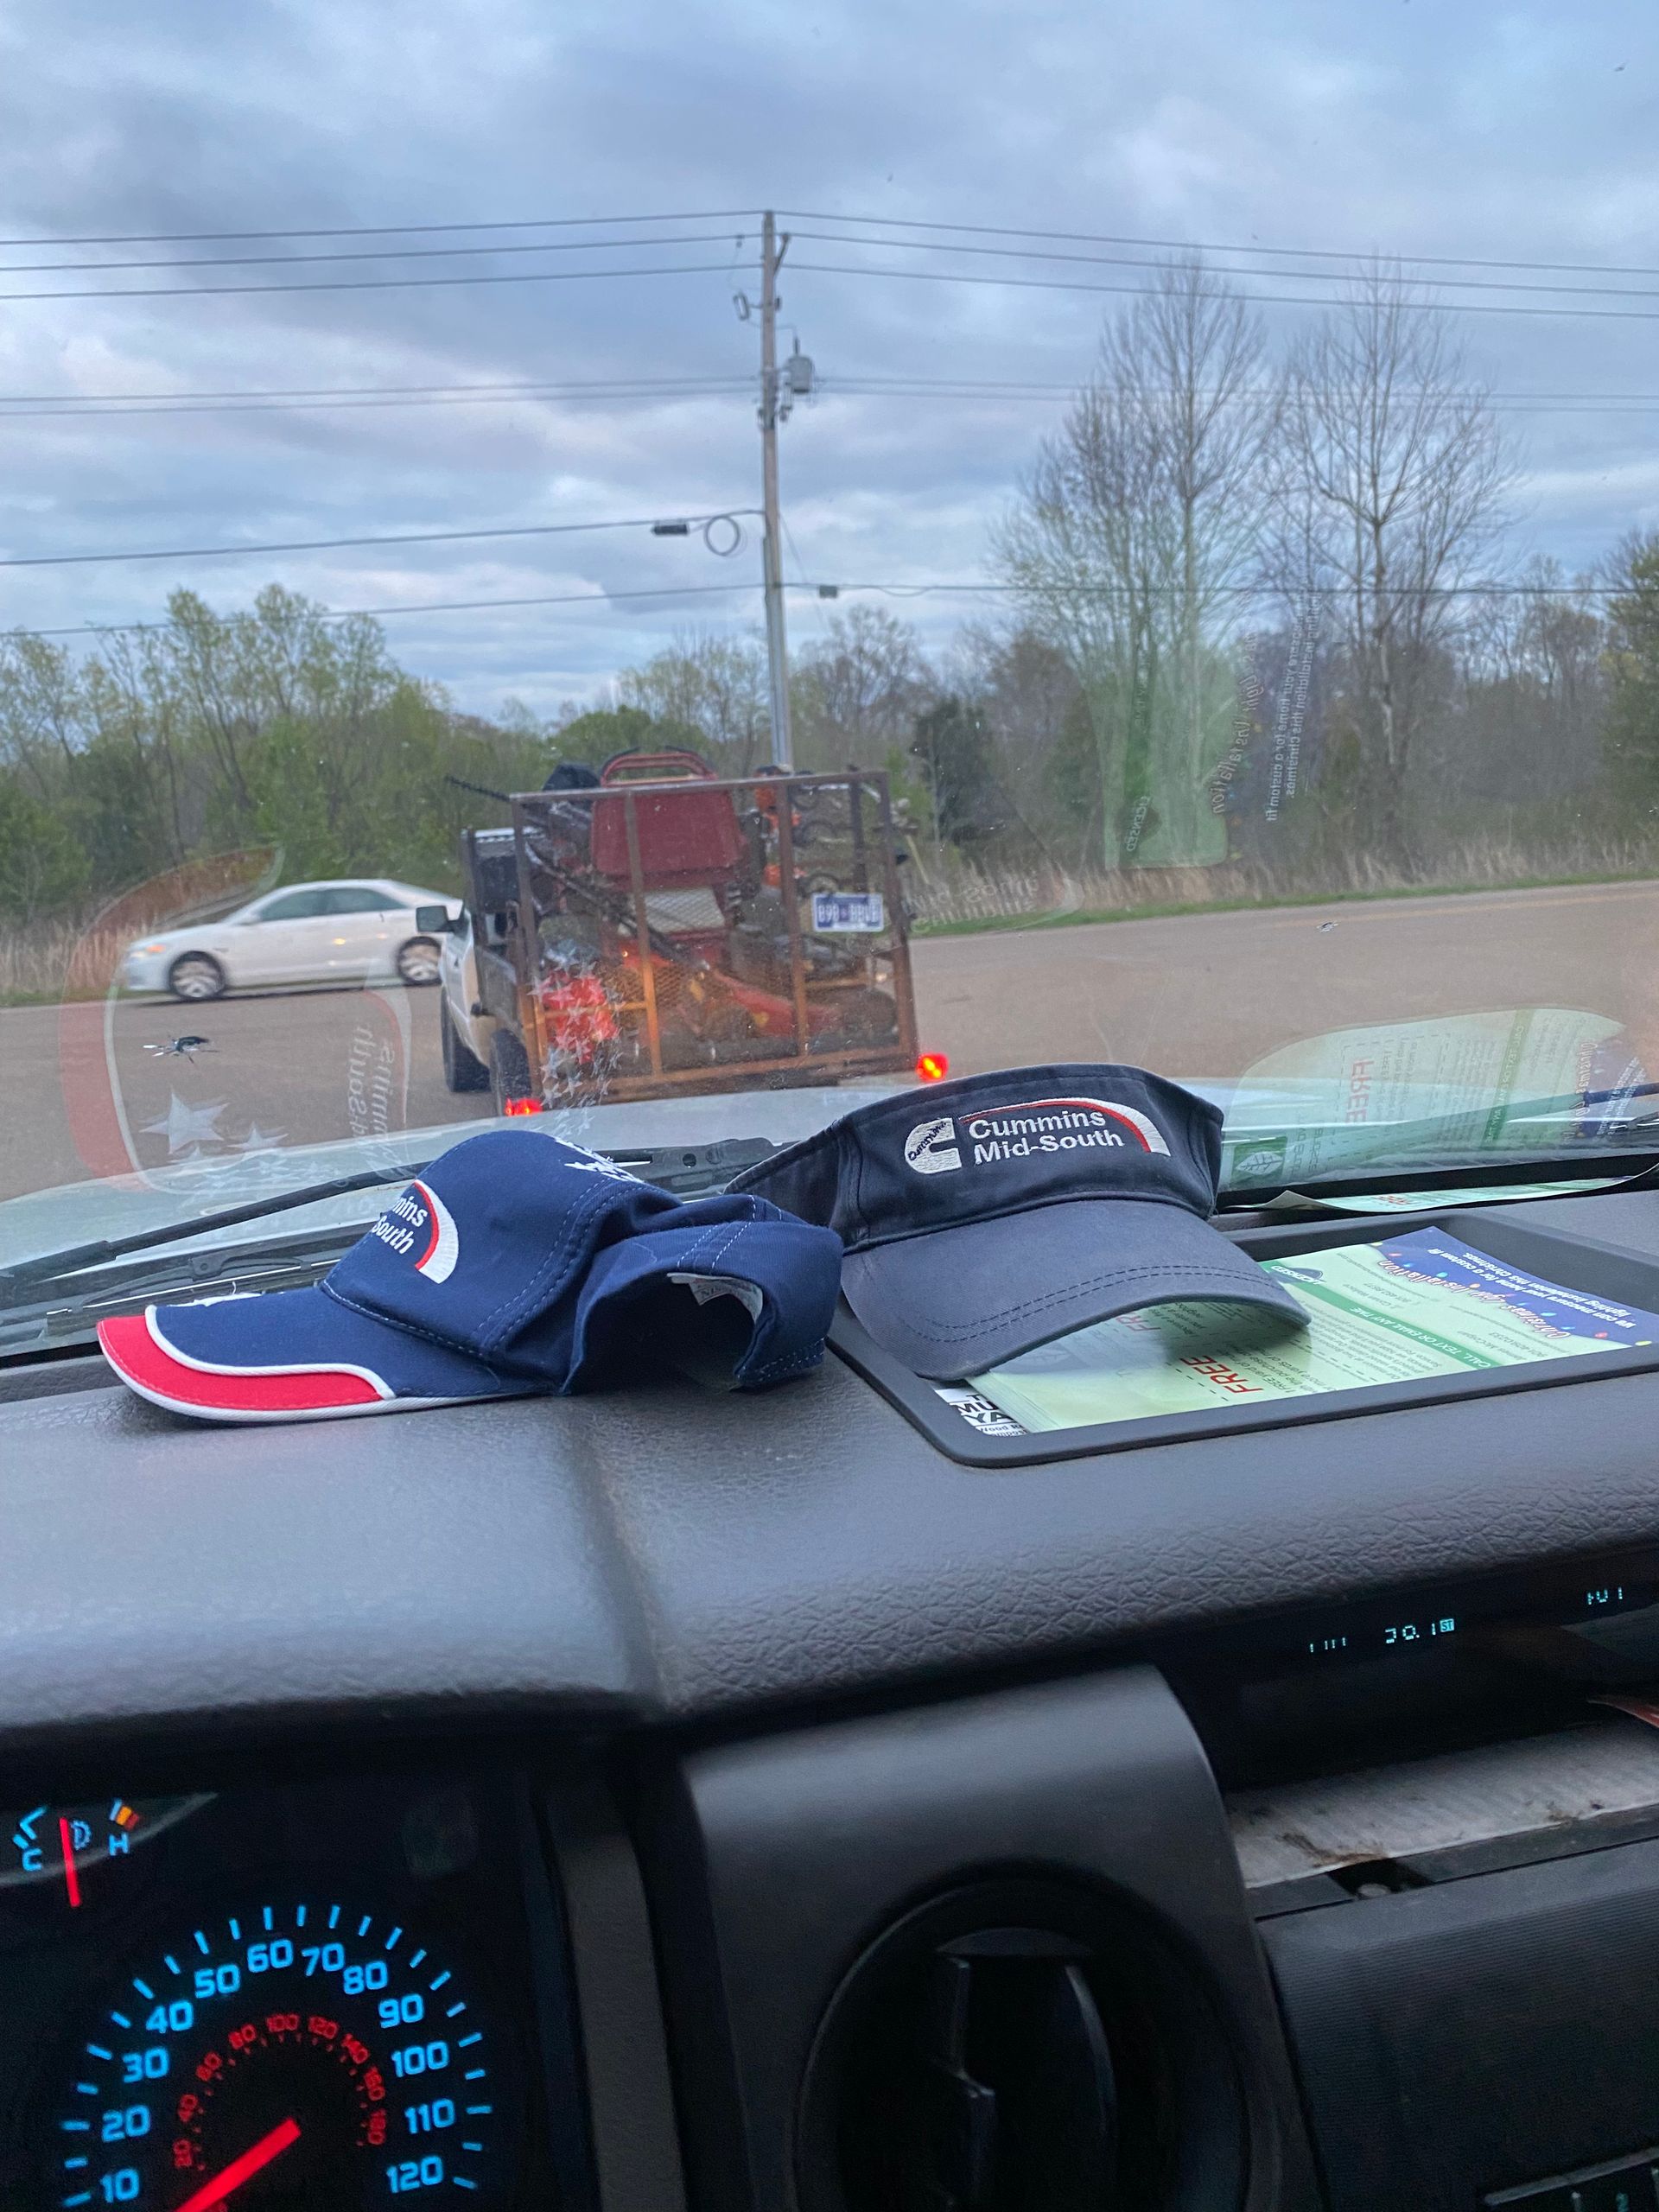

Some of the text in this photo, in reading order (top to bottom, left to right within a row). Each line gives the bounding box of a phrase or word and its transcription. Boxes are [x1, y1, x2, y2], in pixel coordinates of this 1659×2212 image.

[969, 1110, 1106, 1139] Cummins
[974, 1129, 1125, 1165] Mid-South
[1268, 1264, 1326, 1284] LICENSED
[1112, 1314, 1162, 1331] FR
[1370, 1315, 1395, 1325] ANY
[1431, 1341, 1462, 1354] TEXT
[1178, 1354, 1264, 1393] FREE
[950, 1400, 1000, 1414] MU
[962, 1411, 1017, 1424] YA
[247, 1938, 294, 1974] 60
[302, 1942, 346, 1977] 70
[194, 1964, 241, 1999] 50
[342, 1961, 389, 1996] 80
[145, 1999, 194, 2034] 40
[378, 1993, 424, 2029] 90
[123, 2046, 170, 2083] 30
[391, 2040, 451, 2078] 100
[101, 2105, 152, 2143] 20
[404, 2098, 456, 2134] 110
[99, 2169, 141, 2203] 10
[385, 2155, 446, 2194] 120
